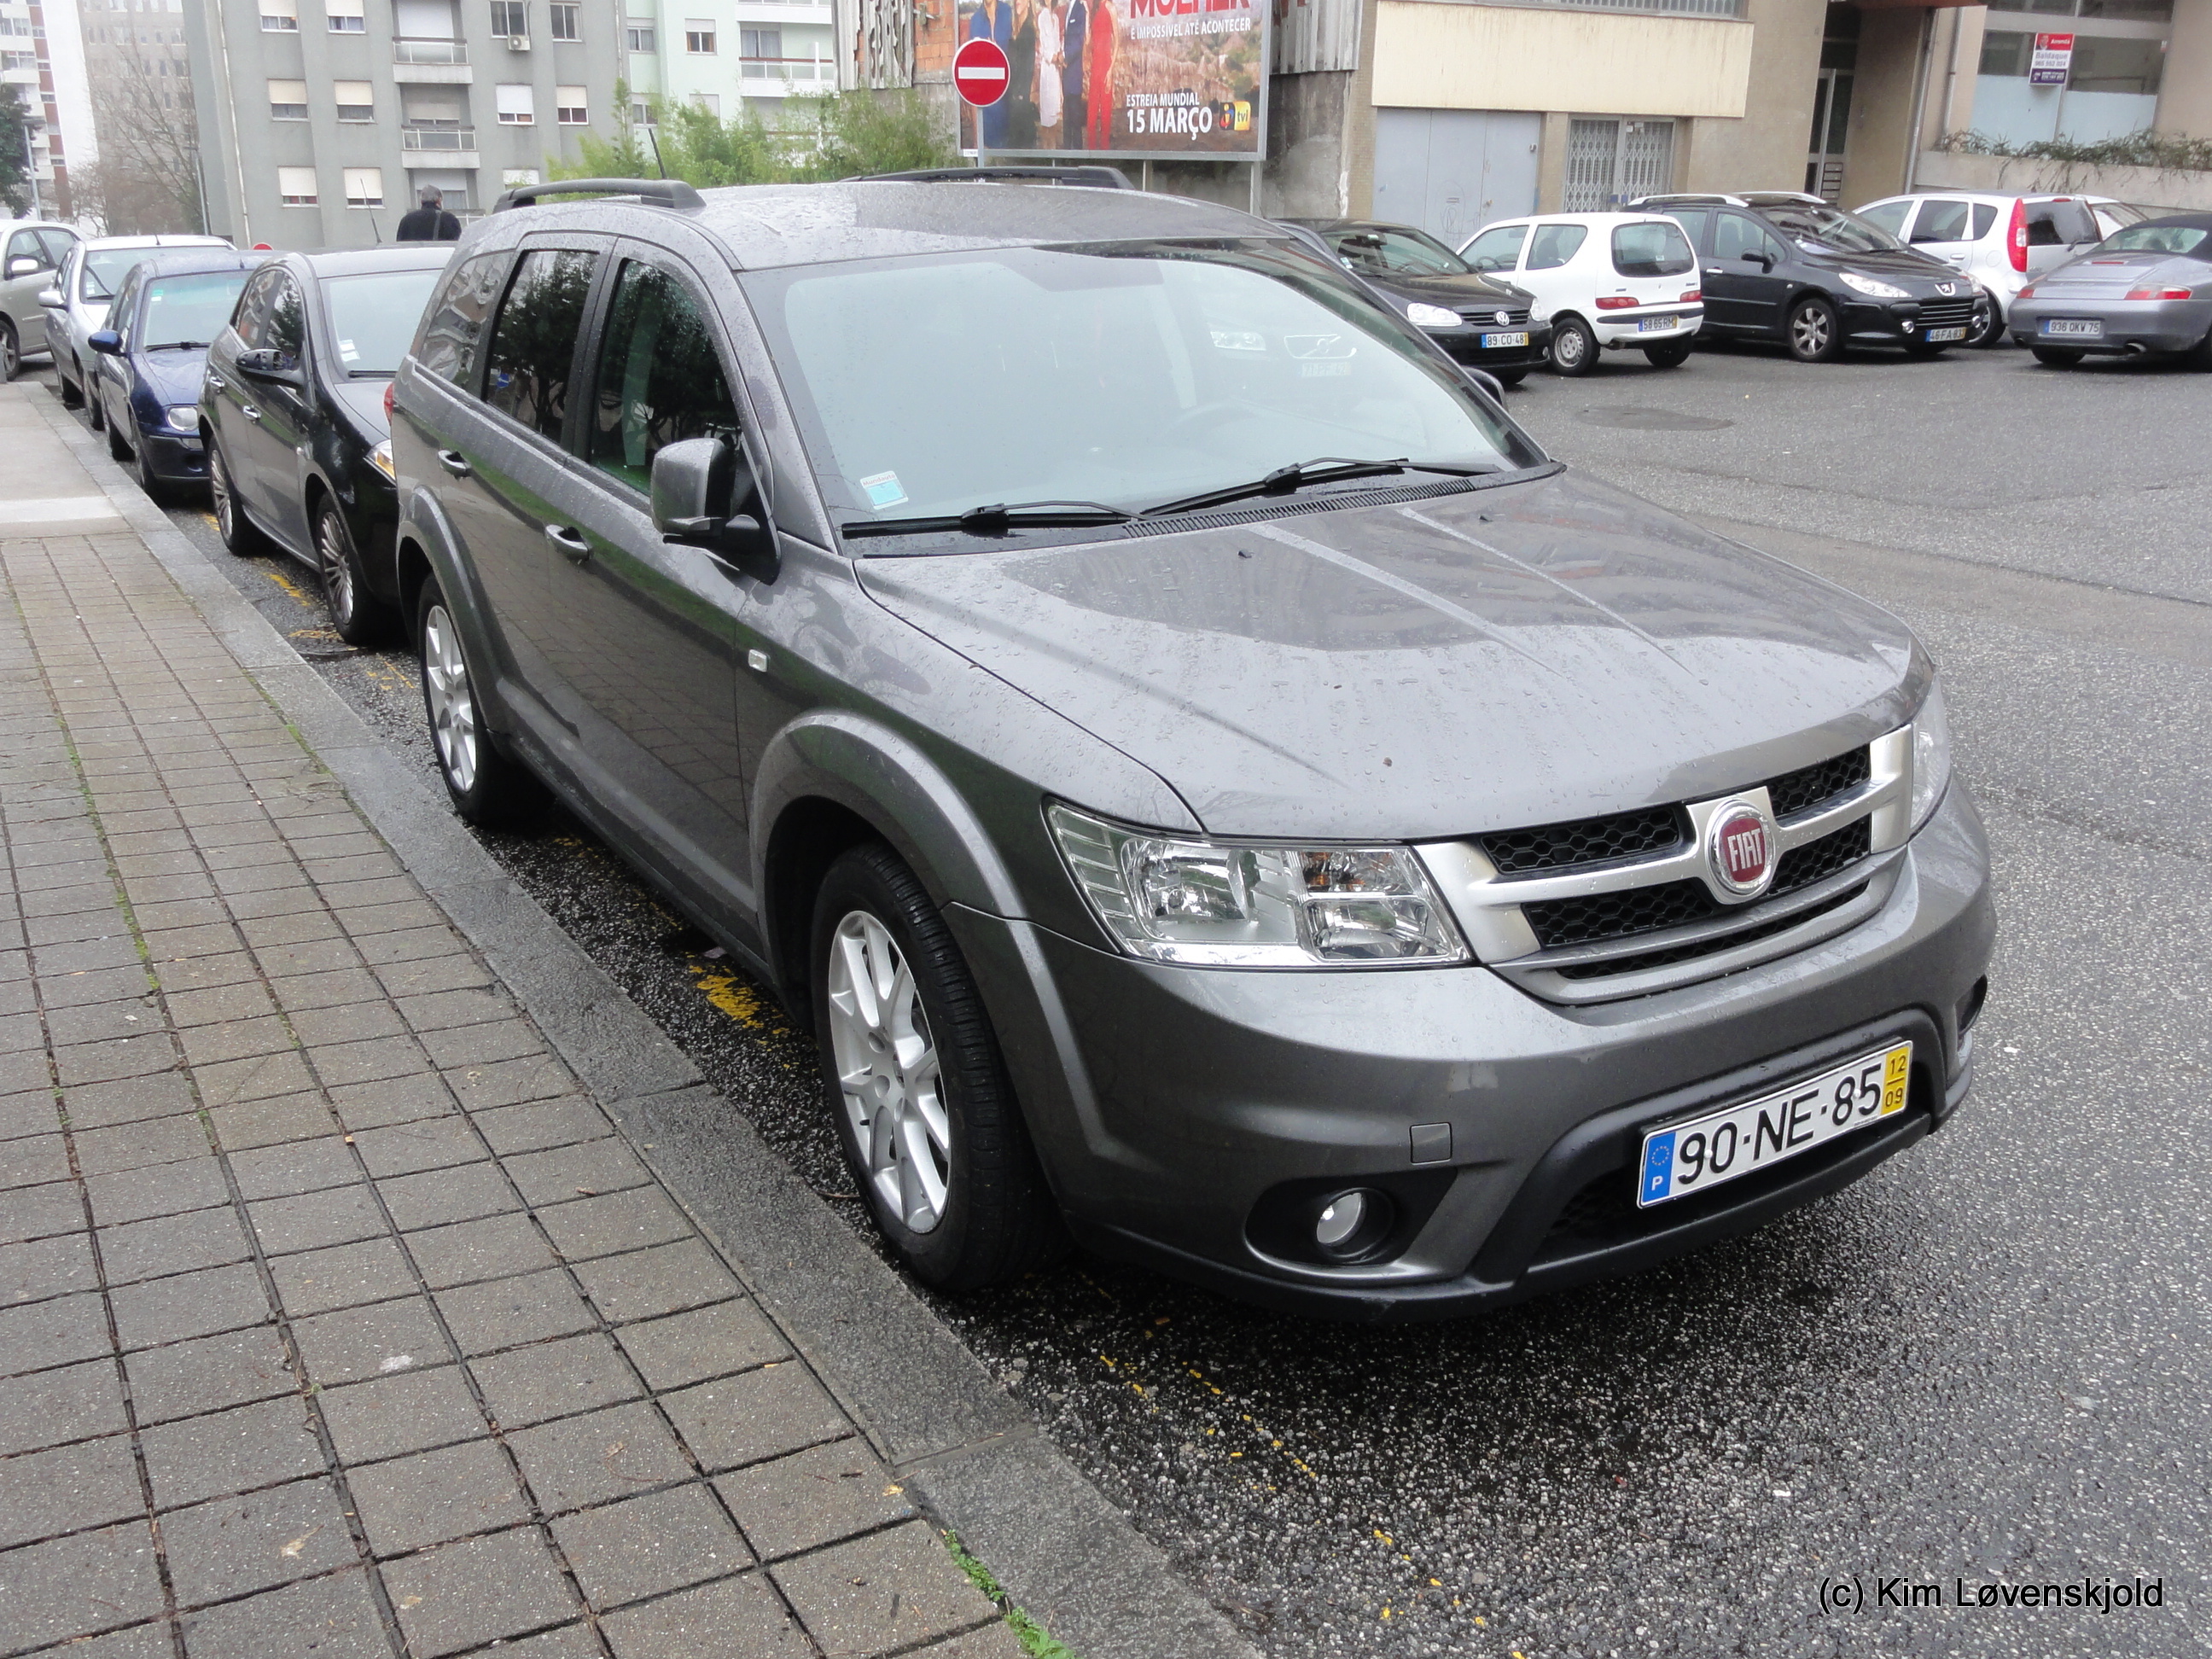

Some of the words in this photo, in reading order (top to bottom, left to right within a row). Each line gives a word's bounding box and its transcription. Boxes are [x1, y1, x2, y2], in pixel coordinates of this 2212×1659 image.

[1131, 26, 1135, 39] É
[1137, 22, 1183, 39] IMPOSSÍVEL
[1185, 19, 1199, 35] ATÉ
[1201, 17, 1251, 35] ACONTECER
[1126, 94, 1158, 107] ESTREIA
[1160, 92, 1200, 107] MUNDIAL
[1126, 109, 1145, 133] 15
[1150, 107, 1213, 140] MARÇO
[1727, 828, 1762, 871] FIAT
[1890, 1055, 1906, 1074] 12
[1885, 1087, 1903, 1107] 09
[1651, 1175, 1663, 1190] P
